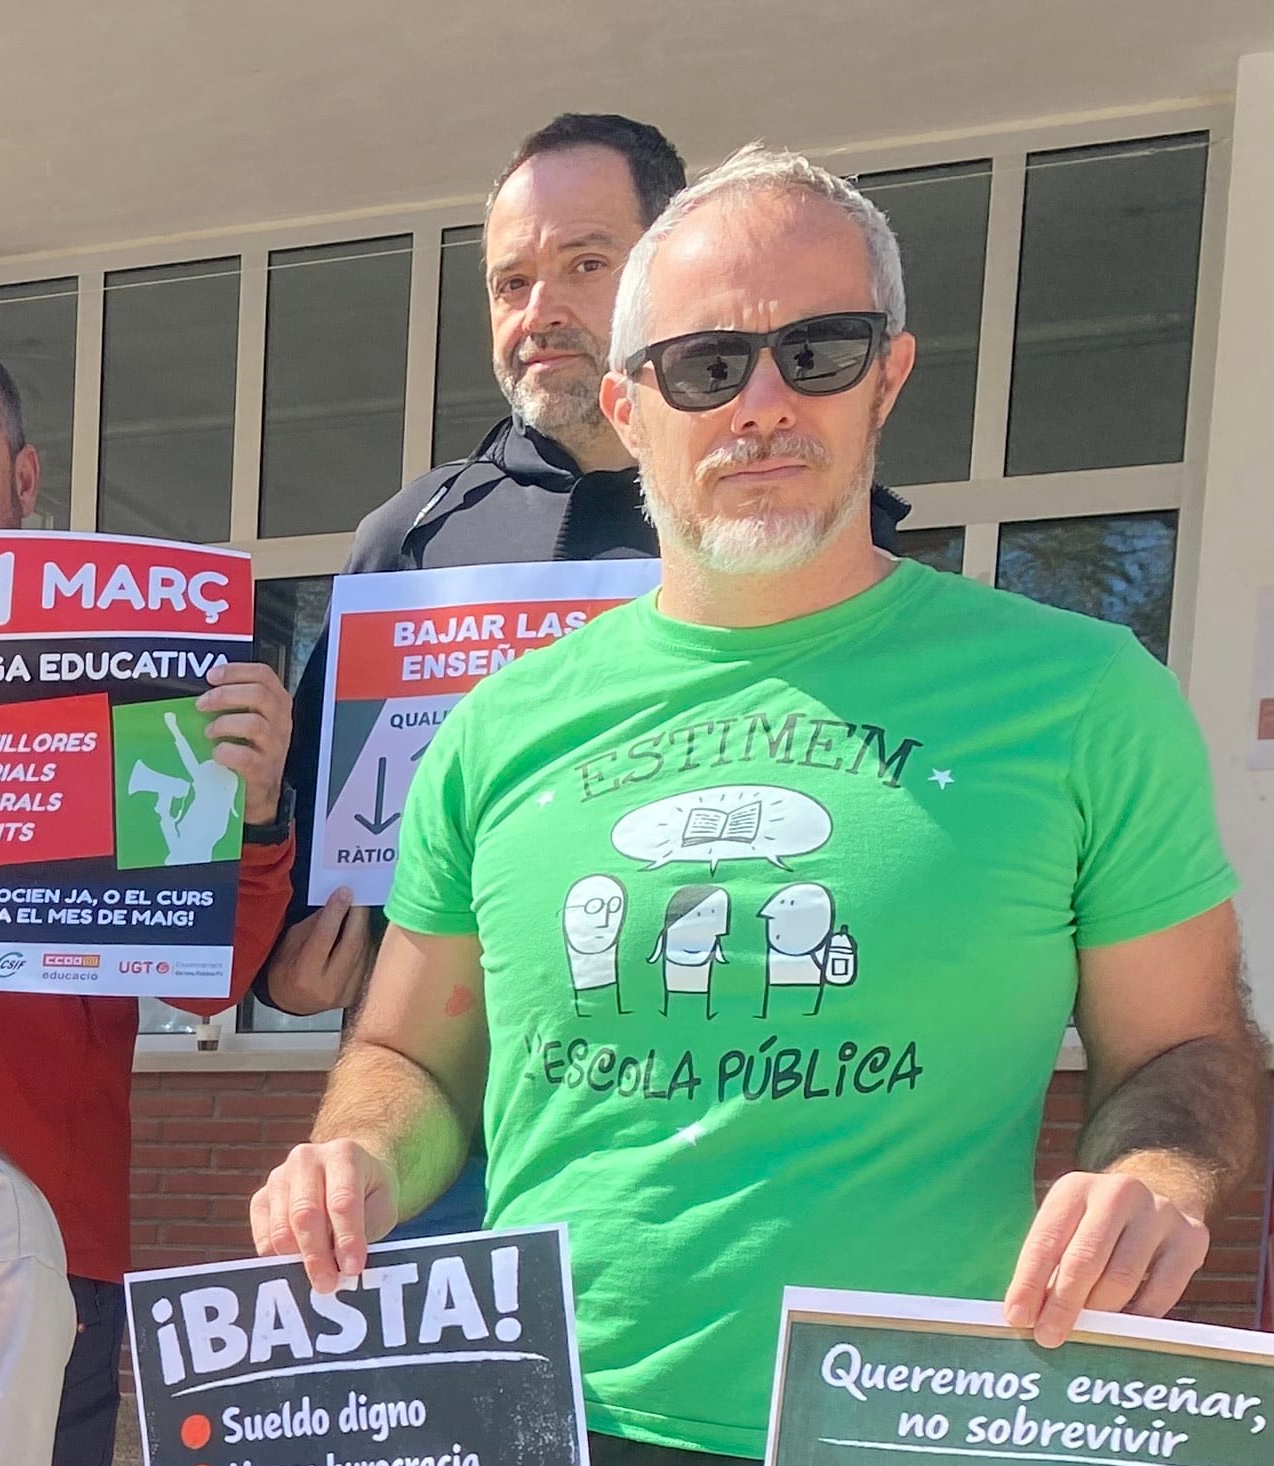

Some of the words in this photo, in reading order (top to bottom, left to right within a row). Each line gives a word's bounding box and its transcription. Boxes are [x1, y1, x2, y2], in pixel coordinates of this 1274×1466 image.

[41, 562, 230, 623] MARÇ
[393, 614, 505, 647] BAJAR
[402, 644, 536, 681] ENSEÑ
[574, 712, 923, 802] ESTIMEM
[337, 845, 399, 864] RÀTIO
[16, 908, 42, 923] EL
[48, 908, 92, 925] MES
[98, 909, 126, 925] DE
[131, 909, 194, 926] MAIG!
[64, 889, 97, 907] JA,
[103, 889, 120, 905] O
[125, 890, 151, 905] EL
[156, 890, 214, 906] CURS
[0, 958, 26, 971] CSIF
[119, 960, 152, 974] UGT
[719, 1035, 924, 1102] PÚBLICA
[151, 1245, 522, 1387] ¡BASTA!
[820, 1342, 1042, 1402] Queremos
[1067, 1375, 1267, 1434] enseñar,
[222, 1396, 330, 1444] Sueldo
[338, 1391, 426, 1442] digno
[898, 1411, 949, 1440] no
[965, 1405, 1189, 1458] sobrevivir
